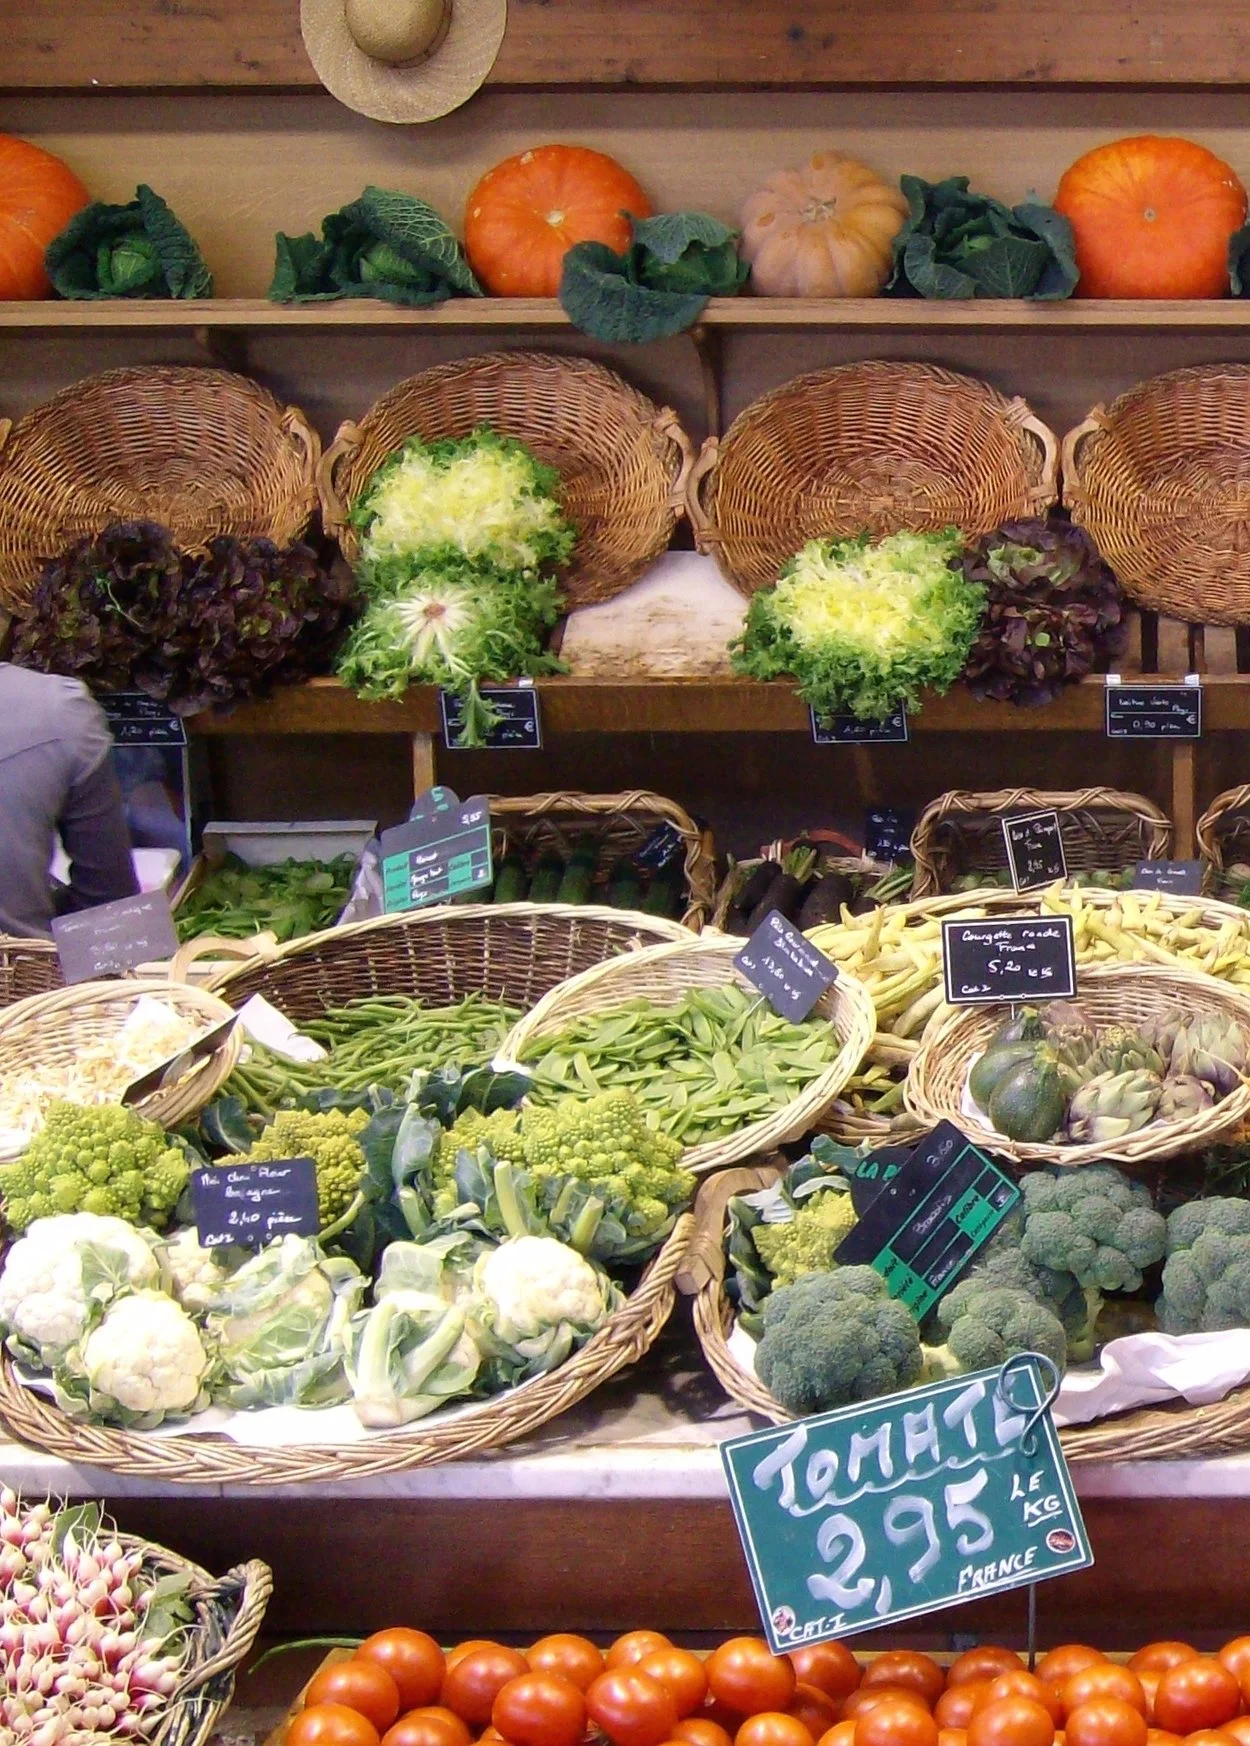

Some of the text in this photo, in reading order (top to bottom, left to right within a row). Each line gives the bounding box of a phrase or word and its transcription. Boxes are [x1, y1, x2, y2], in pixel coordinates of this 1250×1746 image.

[1022, 928, 1062, 938] ronde
[987, 959, 1022, 975] 5,20
[856, 1161, 879, 1180] LA
[955, 1195, 979, 1224] Calibre
[753, 1374, 1026, 1508] TOMATE
[1010, 1470, 1045, 1502] LE
[1023, 1493, 1061, 1522] KG
[807, 1467, 994, 1614] 2,95
[957, 1545, 1039, 1595] FRANCE
